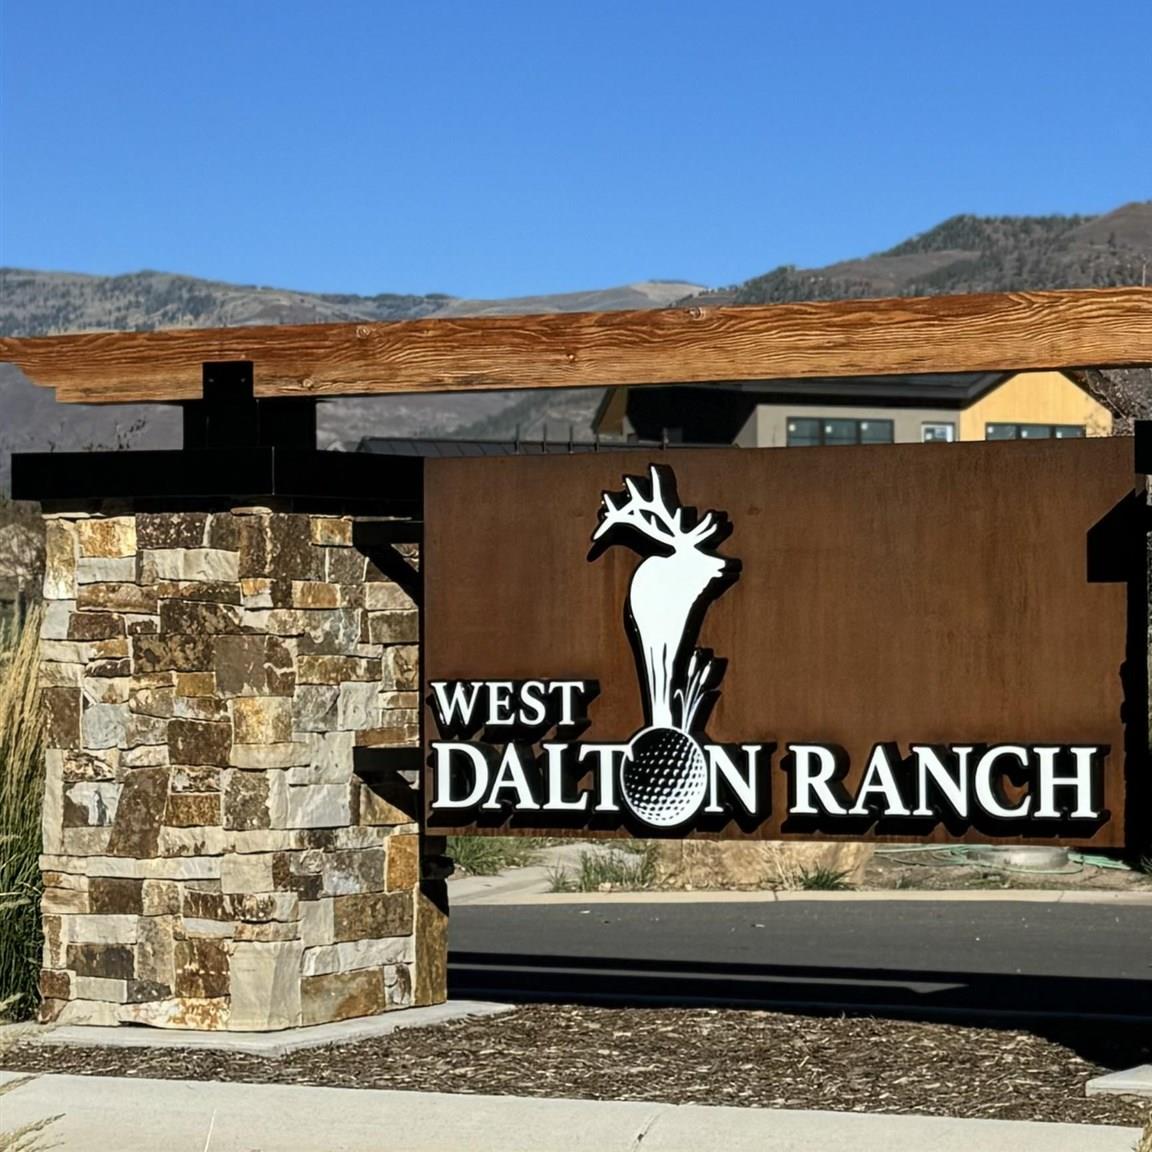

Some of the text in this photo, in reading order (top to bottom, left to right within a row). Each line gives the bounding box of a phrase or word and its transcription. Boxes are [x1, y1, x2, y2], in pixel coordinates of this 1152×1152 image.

[431, 680, 585, 726] WEST
[431, 727, 1098, 828] DALTON RANCH
